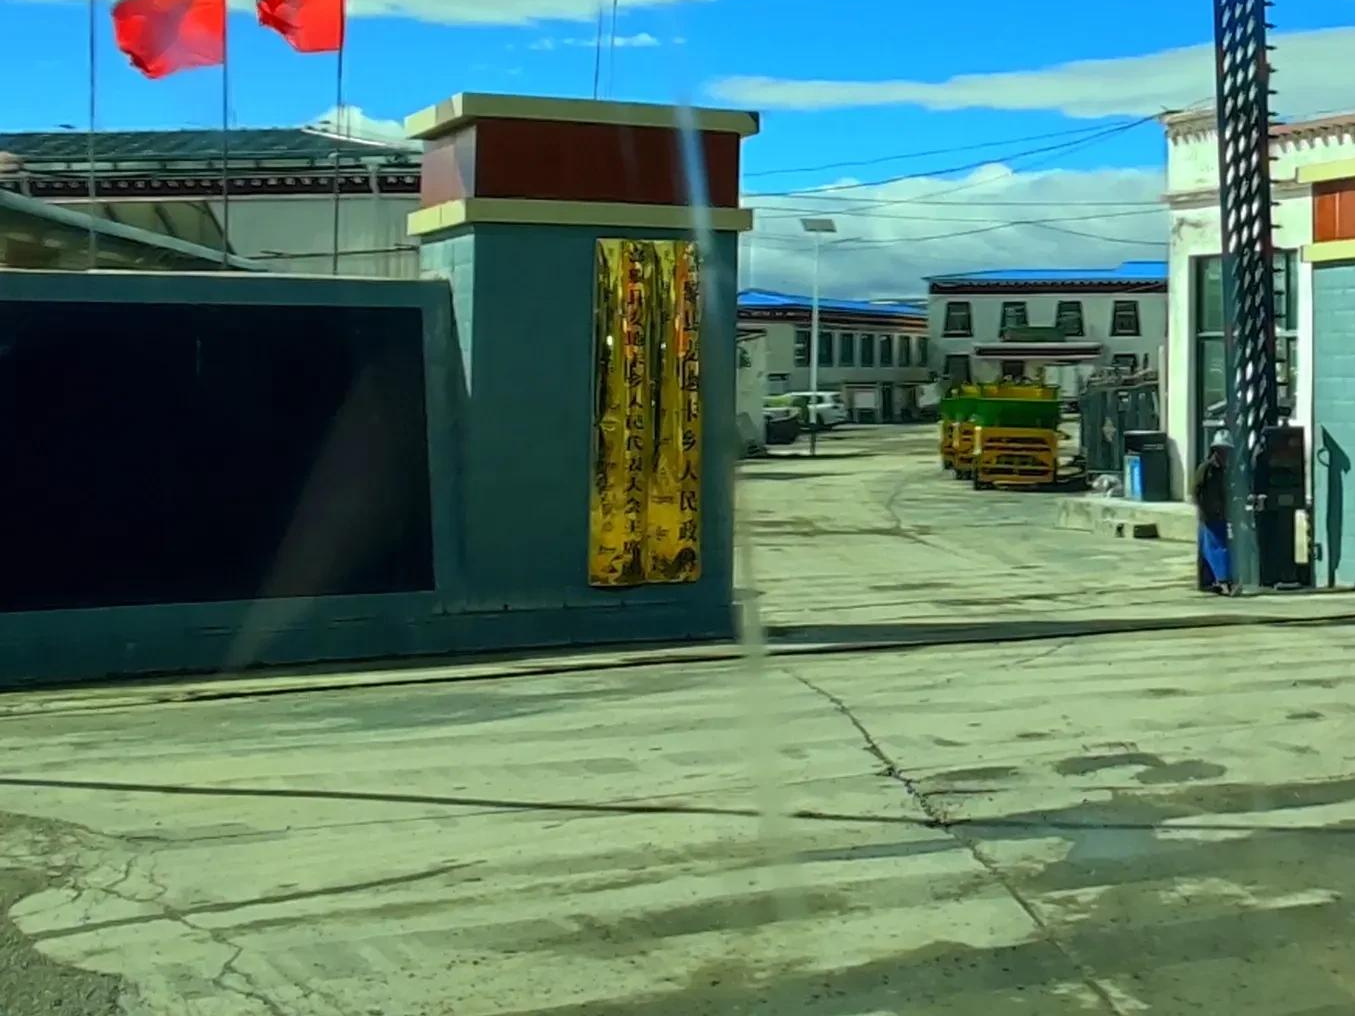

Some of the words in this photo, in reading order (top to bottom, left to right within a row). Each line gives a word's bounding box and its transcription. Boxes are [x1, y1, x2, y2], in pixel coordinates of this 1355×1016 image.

[678, 244, 700, 576] 黎县麦地卡乡人民政
